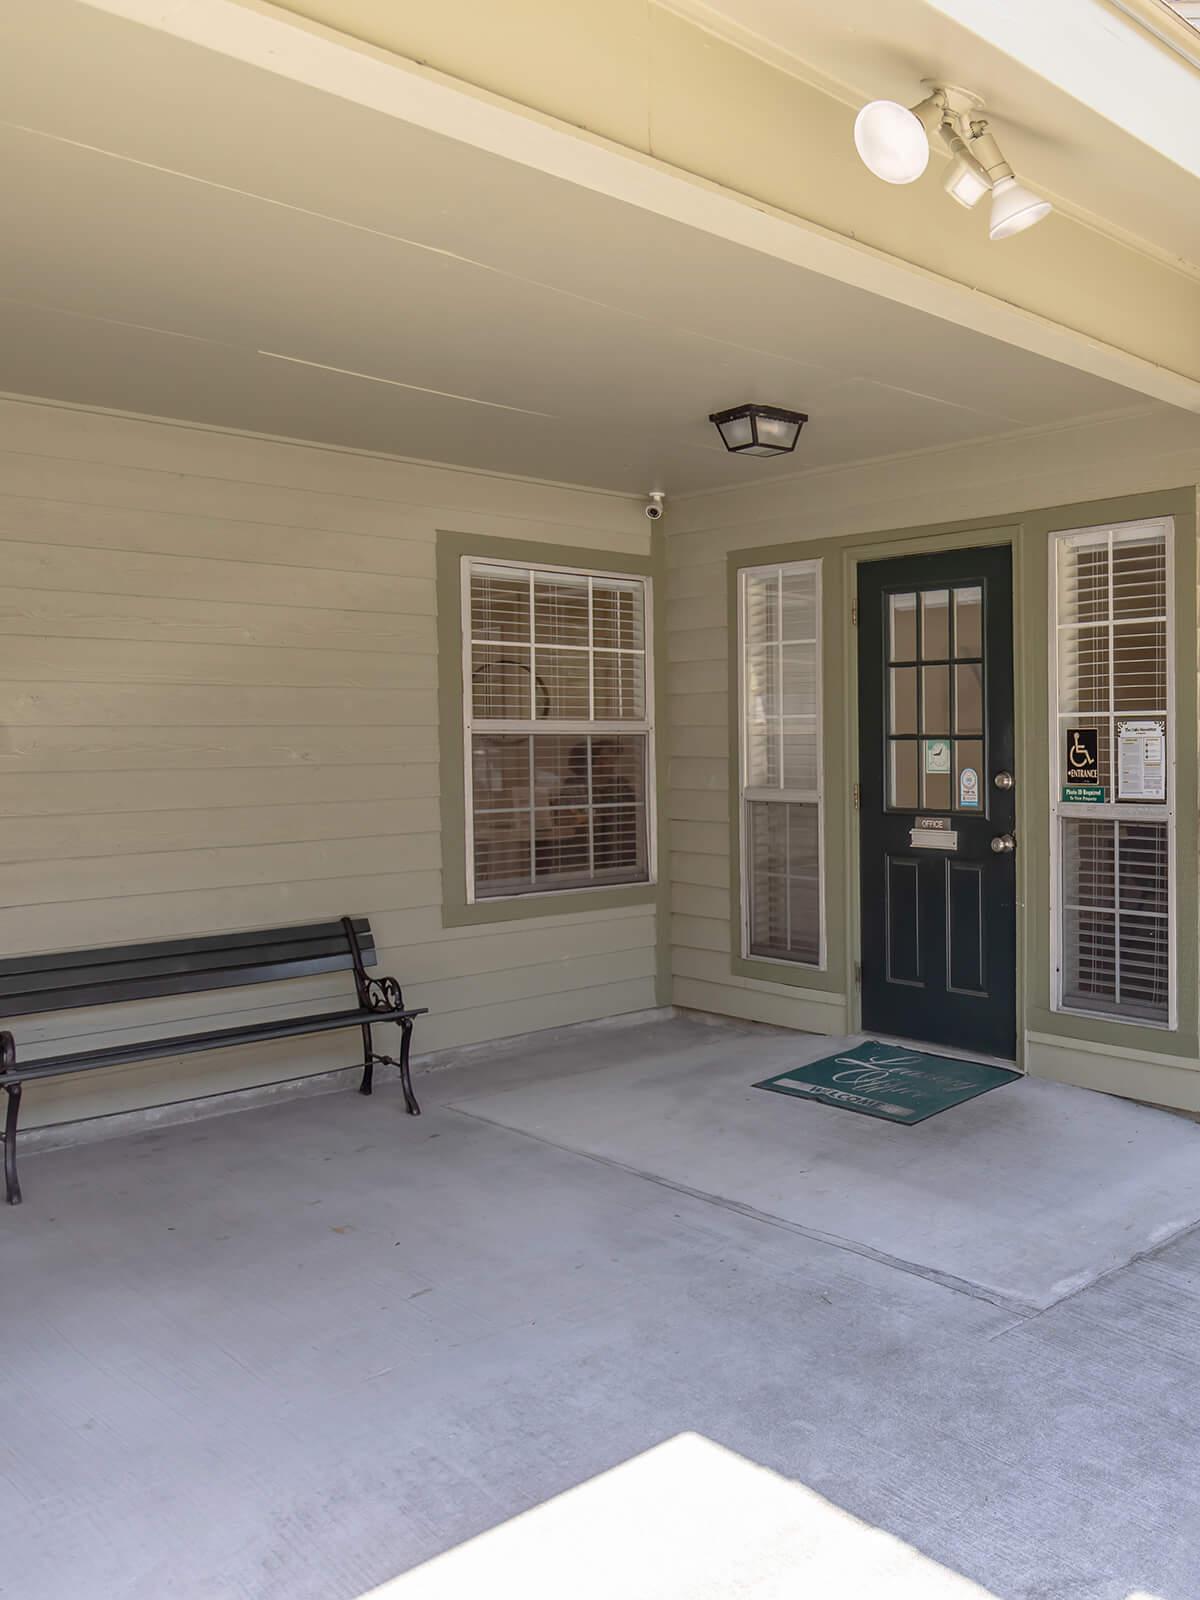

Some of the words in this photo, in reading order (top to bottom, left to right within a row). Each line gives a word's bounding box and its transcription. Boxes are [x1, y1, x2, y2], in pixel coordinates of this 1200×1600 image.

[1072, 769, 1098, 778] ENTRANCE
[922, 820, 943, 828] OFFICE
[810, 1086, 886, 1108] WELCOME
